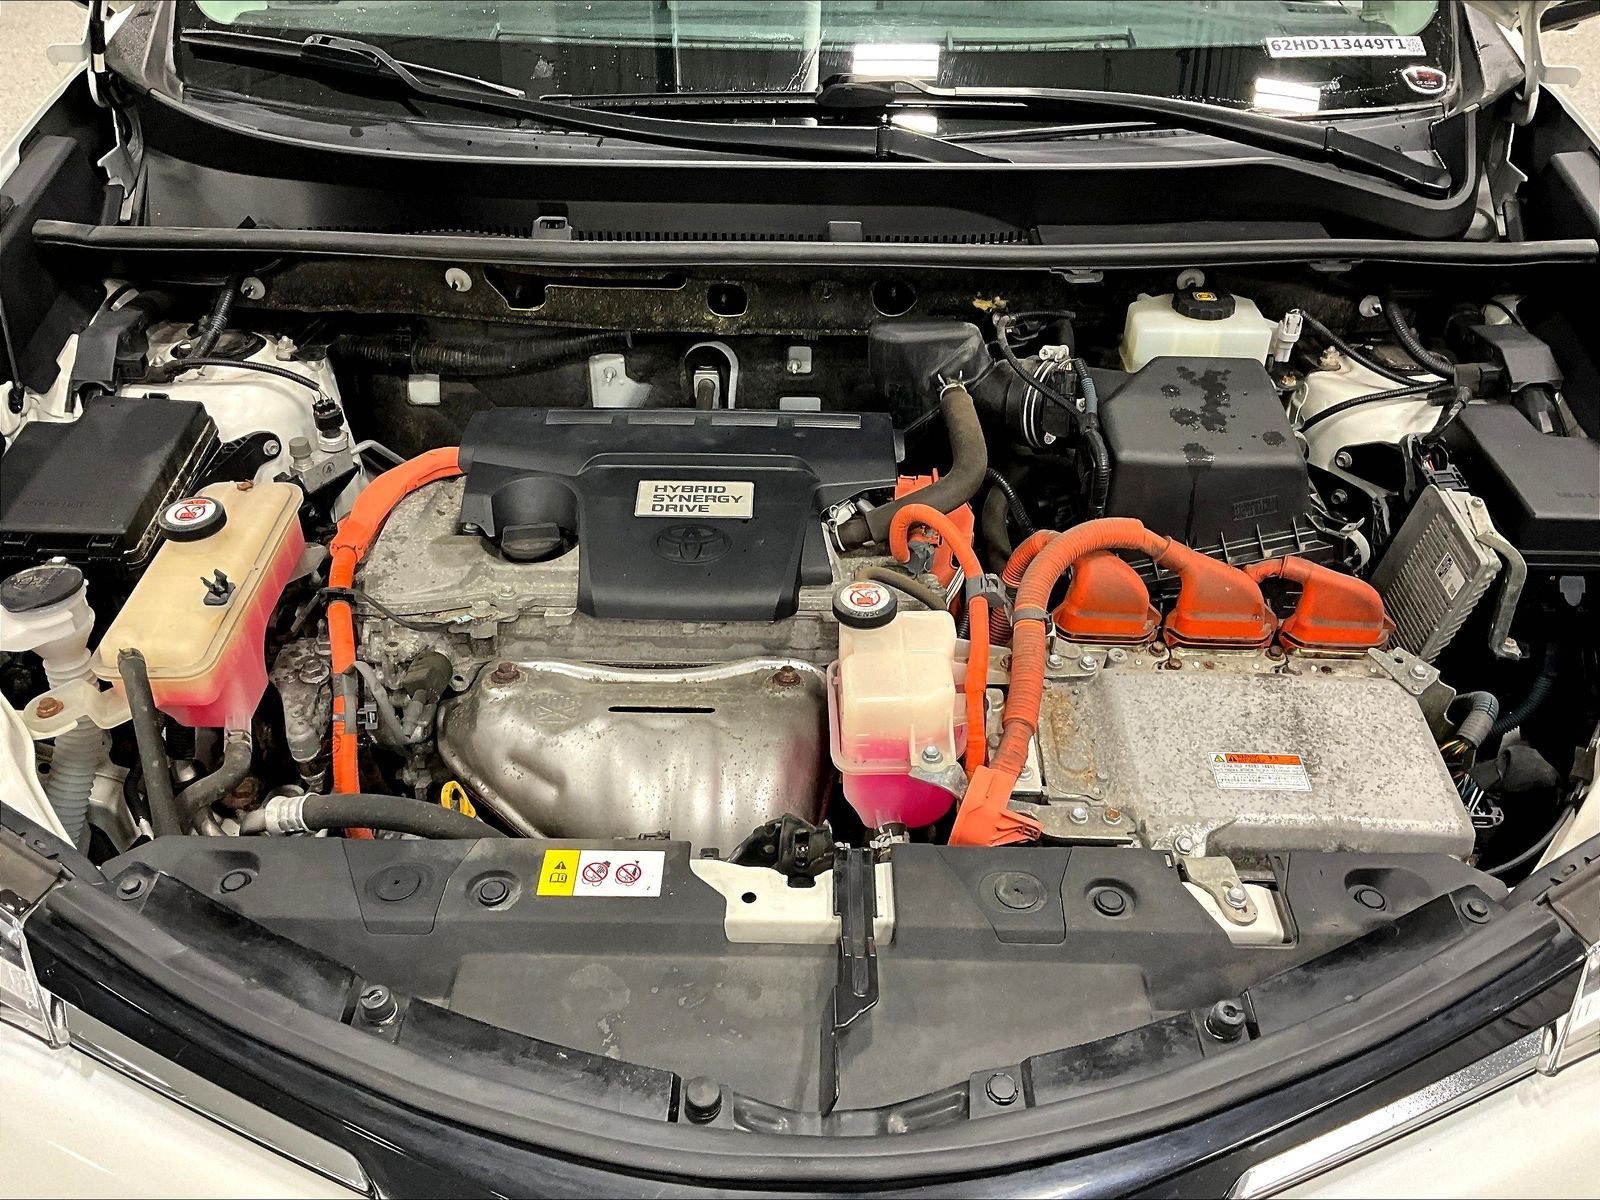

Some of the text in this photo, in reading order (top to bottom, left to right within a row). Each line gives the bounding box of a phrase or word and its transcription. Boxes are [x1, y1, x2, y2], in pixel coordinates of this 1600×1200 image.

[1271, 38, 1407, 51] 62HD113449T1
[654, 485, 727, 493] HYBRID
[653, 494, 743, 503] SYNERGY
[651, 504, 710, 512] DRIVE
